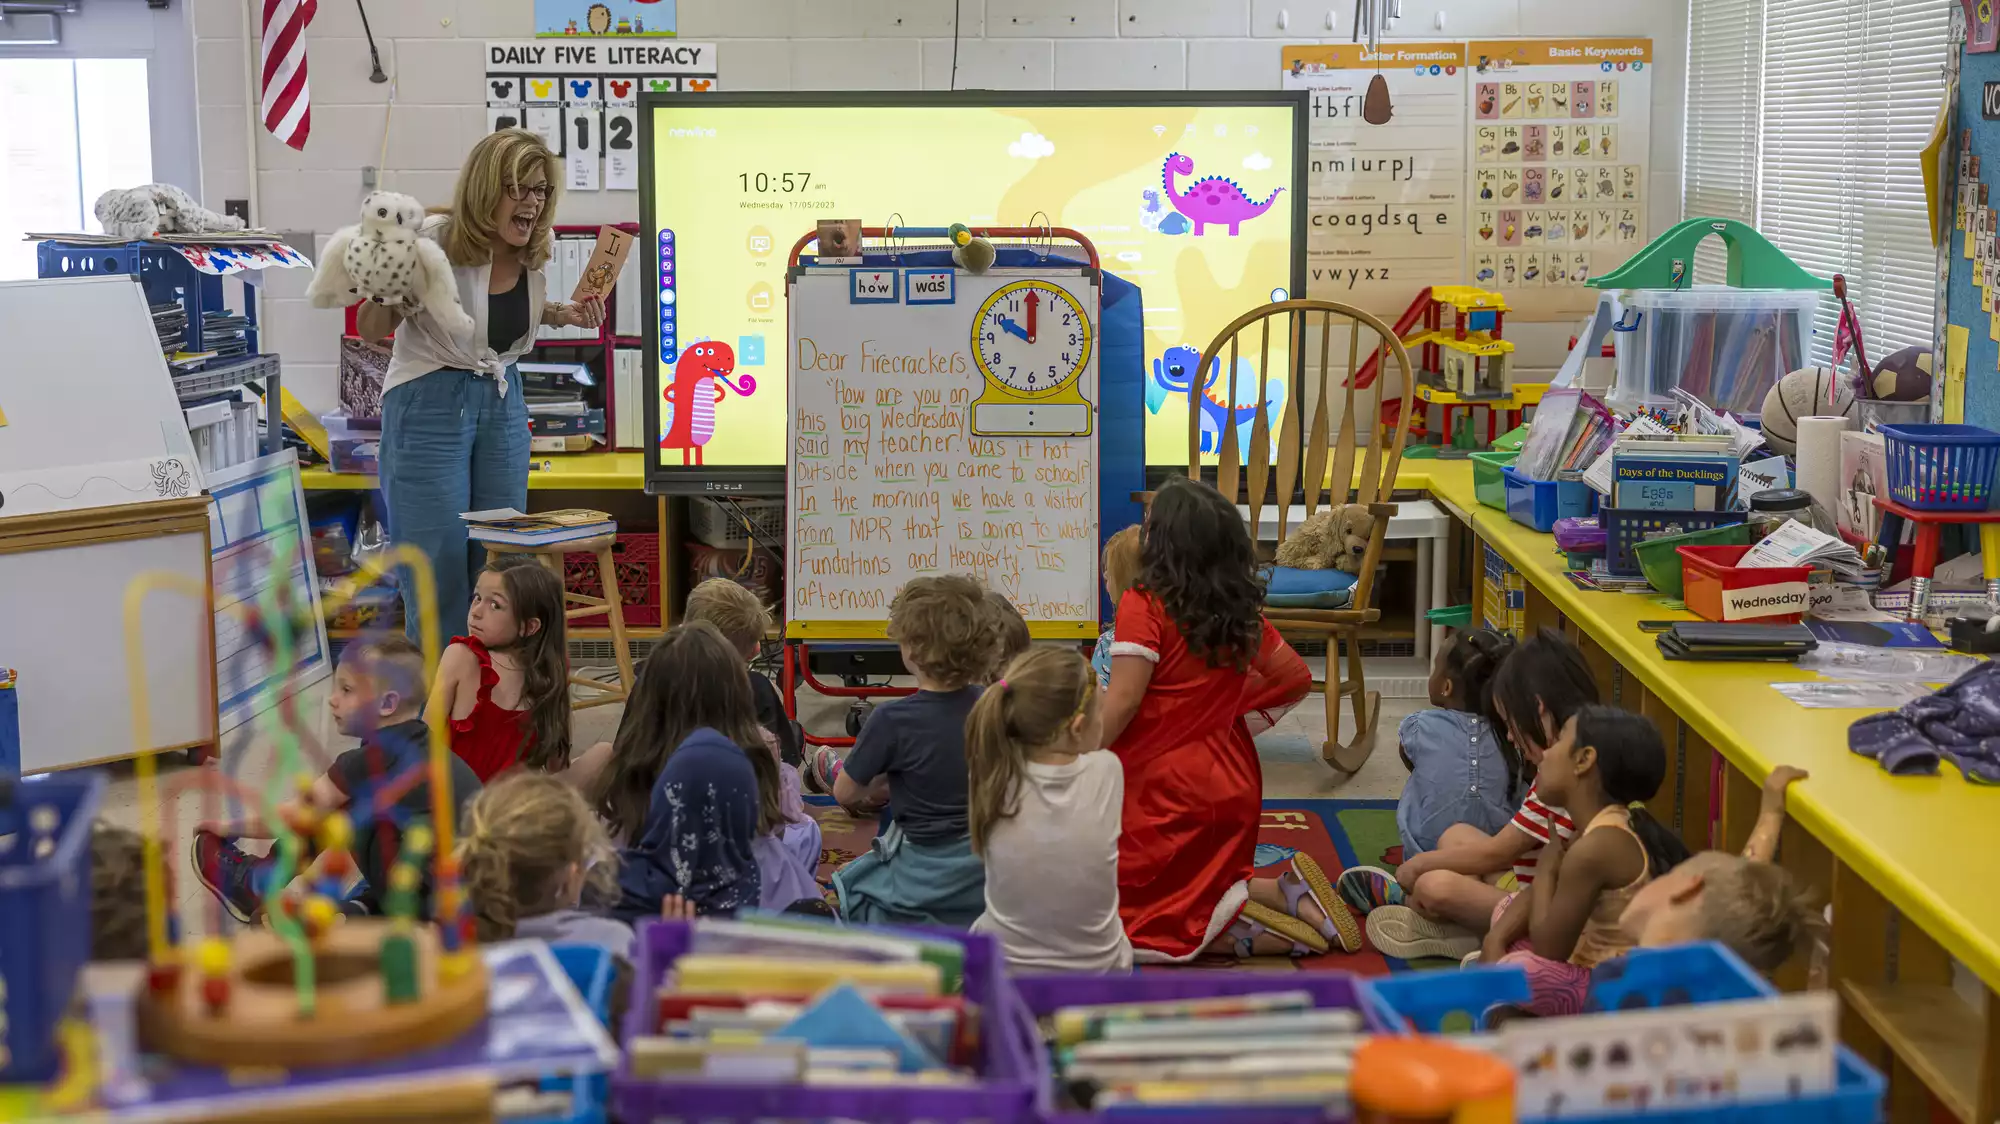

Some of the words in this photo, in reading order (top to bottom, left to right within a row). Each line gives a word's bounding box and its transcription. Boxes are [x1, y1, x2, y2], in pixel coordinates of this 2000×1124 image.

[491, 47, 546, 64] DAILY
[555, 47, 596, 64] FIVE
[608, 47, 701, 65] LITERACY
[1359, 51, 1394, 61] Letter
[1397, 51, 1457, 61] Formation
[1549, 47, 1582, 57] Basic
[1585, 46, 1644, 59] Keywords
[1481, 84, 1495, 95] Aa
[1505, 84, 1517, 95] Bb
[1529, 84, 1542, 95] Cc
[1552, 83, 1566, 94] Dd
[1577, 83, 1589, 94] Ee
[1601, 82, 1612, 93] Ff
[574, 117, 589, 150] 1
[609, 116, 633, 150] 2
[668, 127, 717, 138] newline
[1479, 128, 1495, 140] Gg
[1504, 127, 1517, 137] Hh
[1531, 126, 1540, 137] Ii
[1553, 126, 1564, 139] Jj
[1576, 125, 1588, 136] Kk
[1601, 126, 1610, 136] Ll
[1477, 170, 1496, 180] Mm
[1503, 170, 1517, 180] Nn
[1526, 169, 1542, 180] Oo
[1552, 169, 1564, 182] Pp
[1600, 168, 1610, 178] Rr
[1624, 168, 1634, 179] Ss
[739, 172, 812, 193] 10:57
[739, 201, 784, 211] Wednesday
[789, 201, 835, 210] 17/05/2023
[1436, 213, 1447, 224] e
[1481, 212, 1492, 222] Tt
[1503, 212, 1516, 222] Uu
[1527, 212, 1540, 222] Vv
[1548, 211, 1566, 222] Ww
[1574, 211, 1587, 221] Xx
[1598, 211, 1610, 223] Yy
[1622, 210, 1634, 221] Zz
[604, 232, 621, 257] Ii
[1480, 255, 1492, 265] wh
[1504, 254, 1514, 264] ch
[1528, 254, 1538, 264] sh
[1551, 253, 1562, 263] th
[1575, 253, 1585, 263] ck
[859, 279, 889, 294] how
[915, 279, 945, 293] was
[1009, 300, 1019, 312] 11
[1050, 300, 1054, 312] 1
[994, 313, 1006, 326] 10
[1062, 314, 1070, 326] 2
[987, 332, 995, 344] 9
[1068, 333, 1077, 346] 3
[799, 337, 849, 372] Dear
[993, 352, 1001, 364] 8
[1061, 353, 1070, 364] 4
[1008, 366, 1017, 379] 7
[1027, 372, 1036, 384] 6
[1048, 366, 1056, 378] 5
[875, 387, 903, 405] are
[913, 389, 941, 413] you
[950, 388, 969, 404] on
[796, 407, 827, 432] this
[841, 408, 871, 440] big
[796, 434, 829, 456] said
[844, 440, 870, 465] my
[1016, 439, 1034, 458] it
[1043, 439, 1076, 460] hot
[874, 456, 915, 479] when
[923, 462, 949, 487] you
[958, 461, 1002, 479] came
[1005, 459, 1024, 483] to
[1618, 467, 1643, 480] Days
[1645, 468, 1656, 478] of
[1658, 469, 1674, 478] the
[1676, 469, 1724, 481] Ducklings
[1641, 486, 1674, 500] Eggs
[797, 485, 817, 512] In
[831, 486, 859, 512] the
[872, 490, 941, 521] morning
[952, 488, 972, 508] we
[981, 485, 1016, 509] have
[1024, 491, 1036, 508] a
[1044, 488, 1088, 510] visitor
[796, 518, 834, 544] from
[850, 516, 892, 543] MPR
[902, 514, 944, 540] that
[957, 516, 973, 539] is
[982, 519, 1026, 550] going
[1030, 515, 1051, 538] to
[798, 546, 892, 578] Fundations
[908, 543, 938, 569] and
[1027, 545, 1065, 569] This
[1730, 592, 1806, 610] Wednesday
